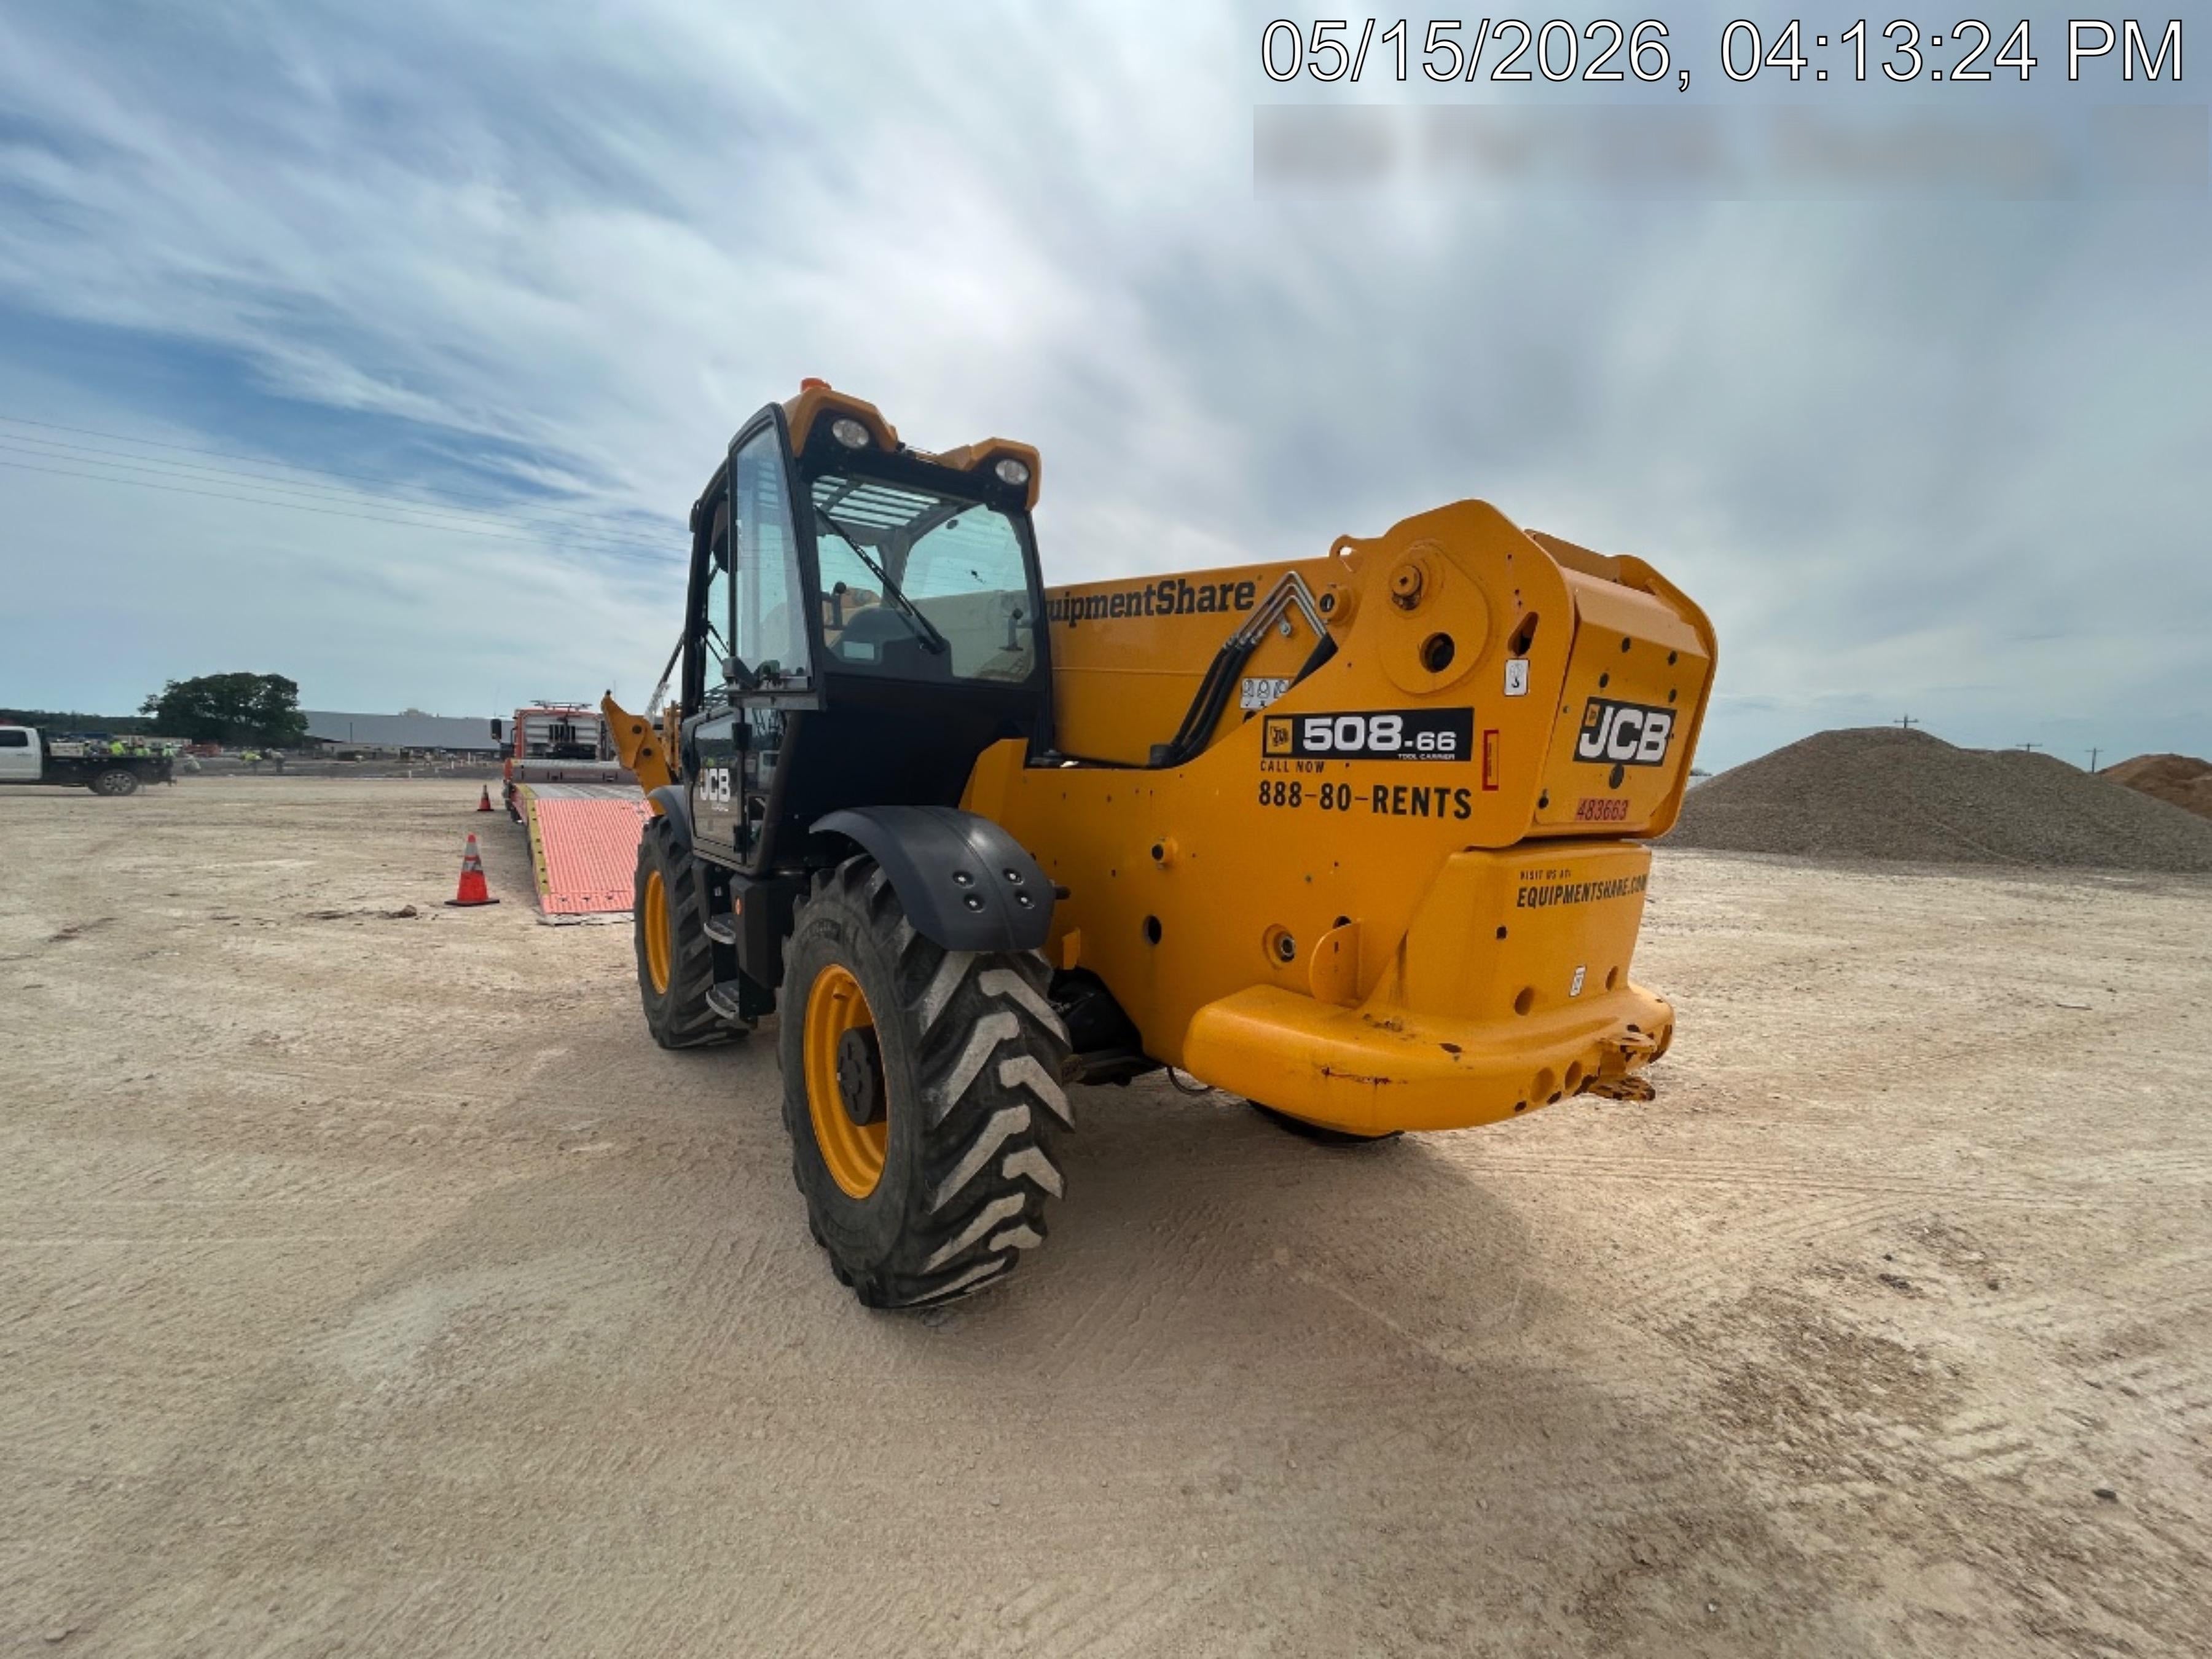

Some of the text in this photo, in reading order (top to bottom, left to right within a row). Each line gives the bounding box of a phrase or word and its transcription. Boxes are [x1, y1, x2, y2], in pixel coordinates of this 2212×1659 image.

[1303, 715, 1457, 751] 508-66
[1579, 705, 1671, 762] JCB
[1260, 761, 1324, 773] CALL NOW
[699, 768, 731, 802] JCB
[1259, 780, 1472, 820] 888-80-RENTS
[1577, 800, 1628, 821] 483663
